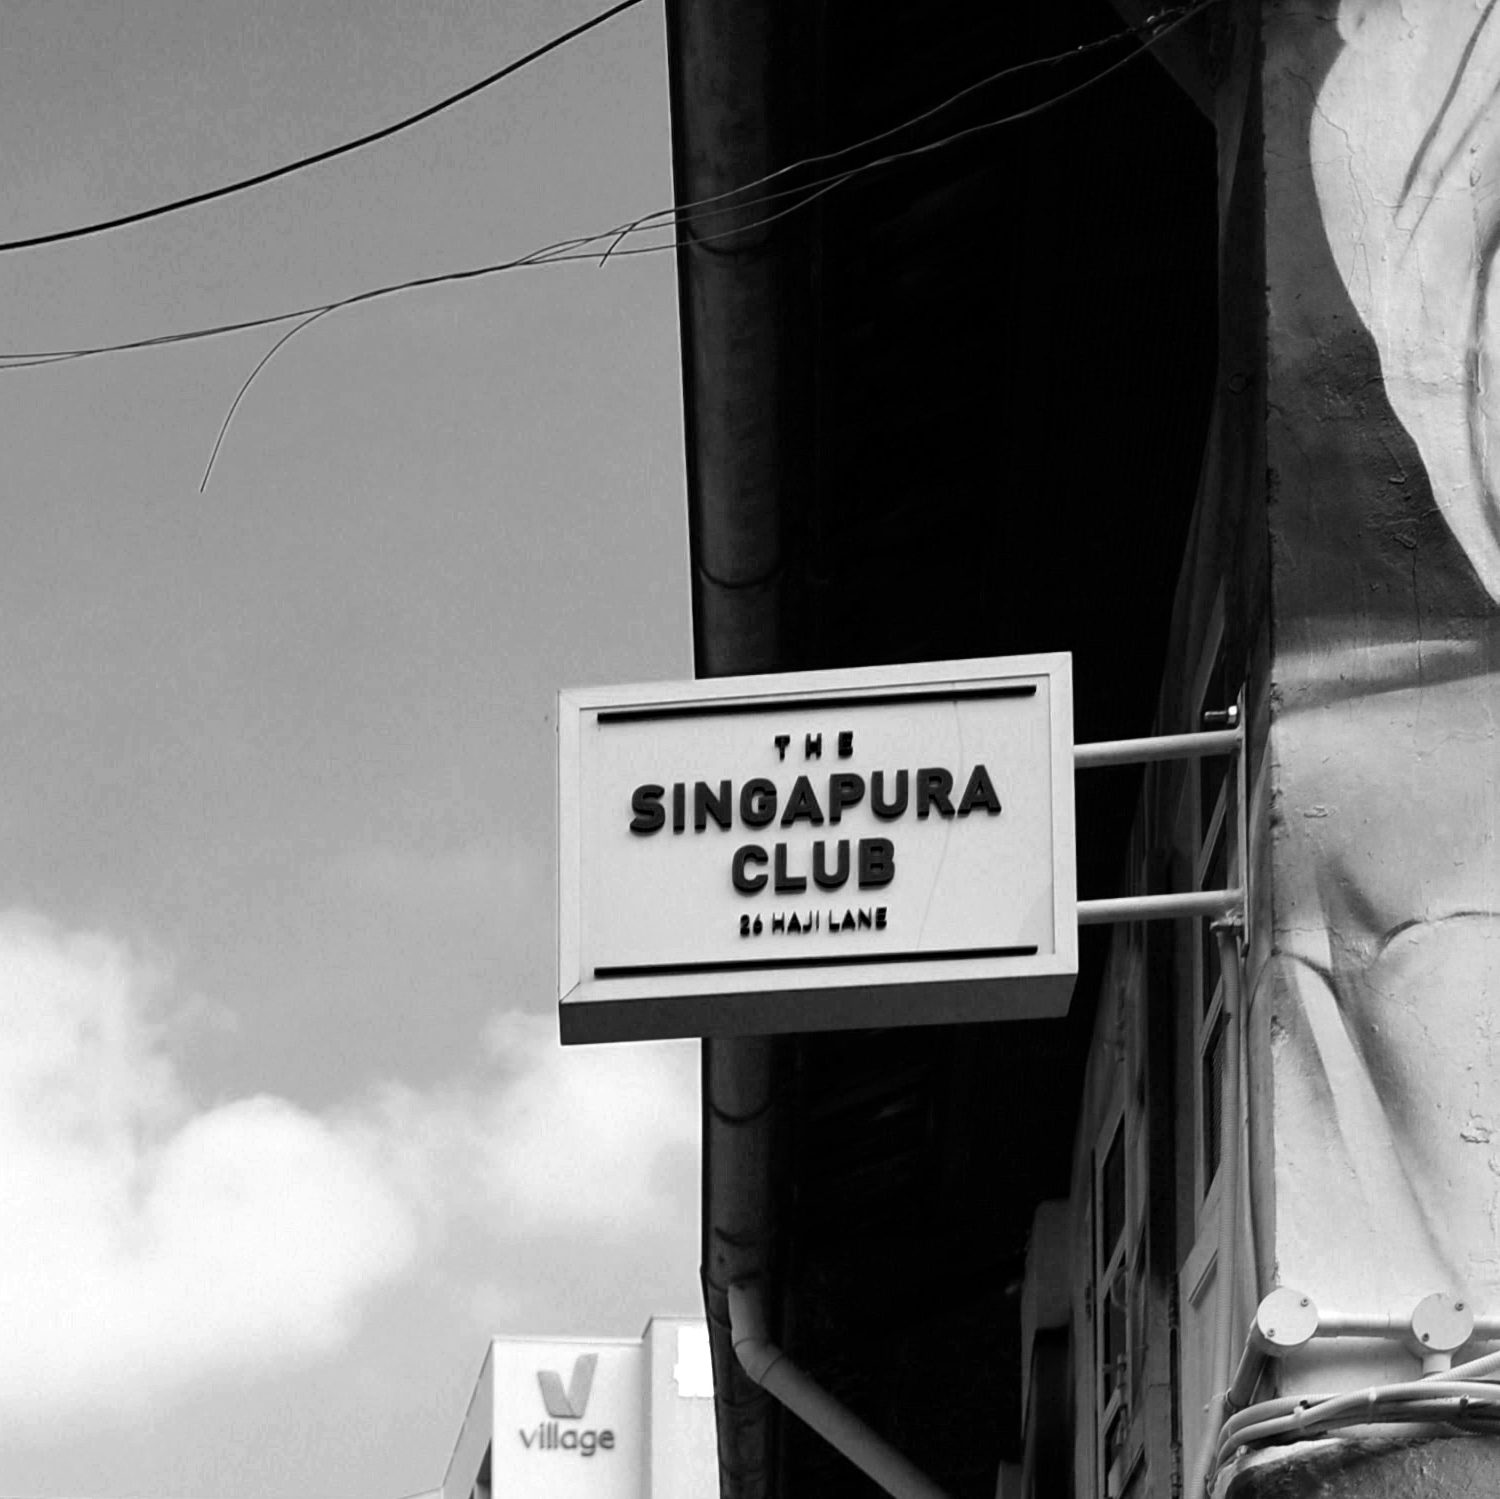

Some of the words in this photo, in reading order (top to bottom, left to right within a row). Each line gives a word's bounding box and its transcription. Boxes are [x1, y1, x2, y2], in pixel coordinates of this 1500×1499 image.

[774, 731, 854, 761] THE
[629, 764, 1002, 834] SINGAPURA
[731, 837, 896, 894] CLUB
[740, 914, 763, 937] 26
[771, 910, 820, 935] HAJI
[828, 907, 888, 932] LANE
[519, 1421, 615, 1457] village
